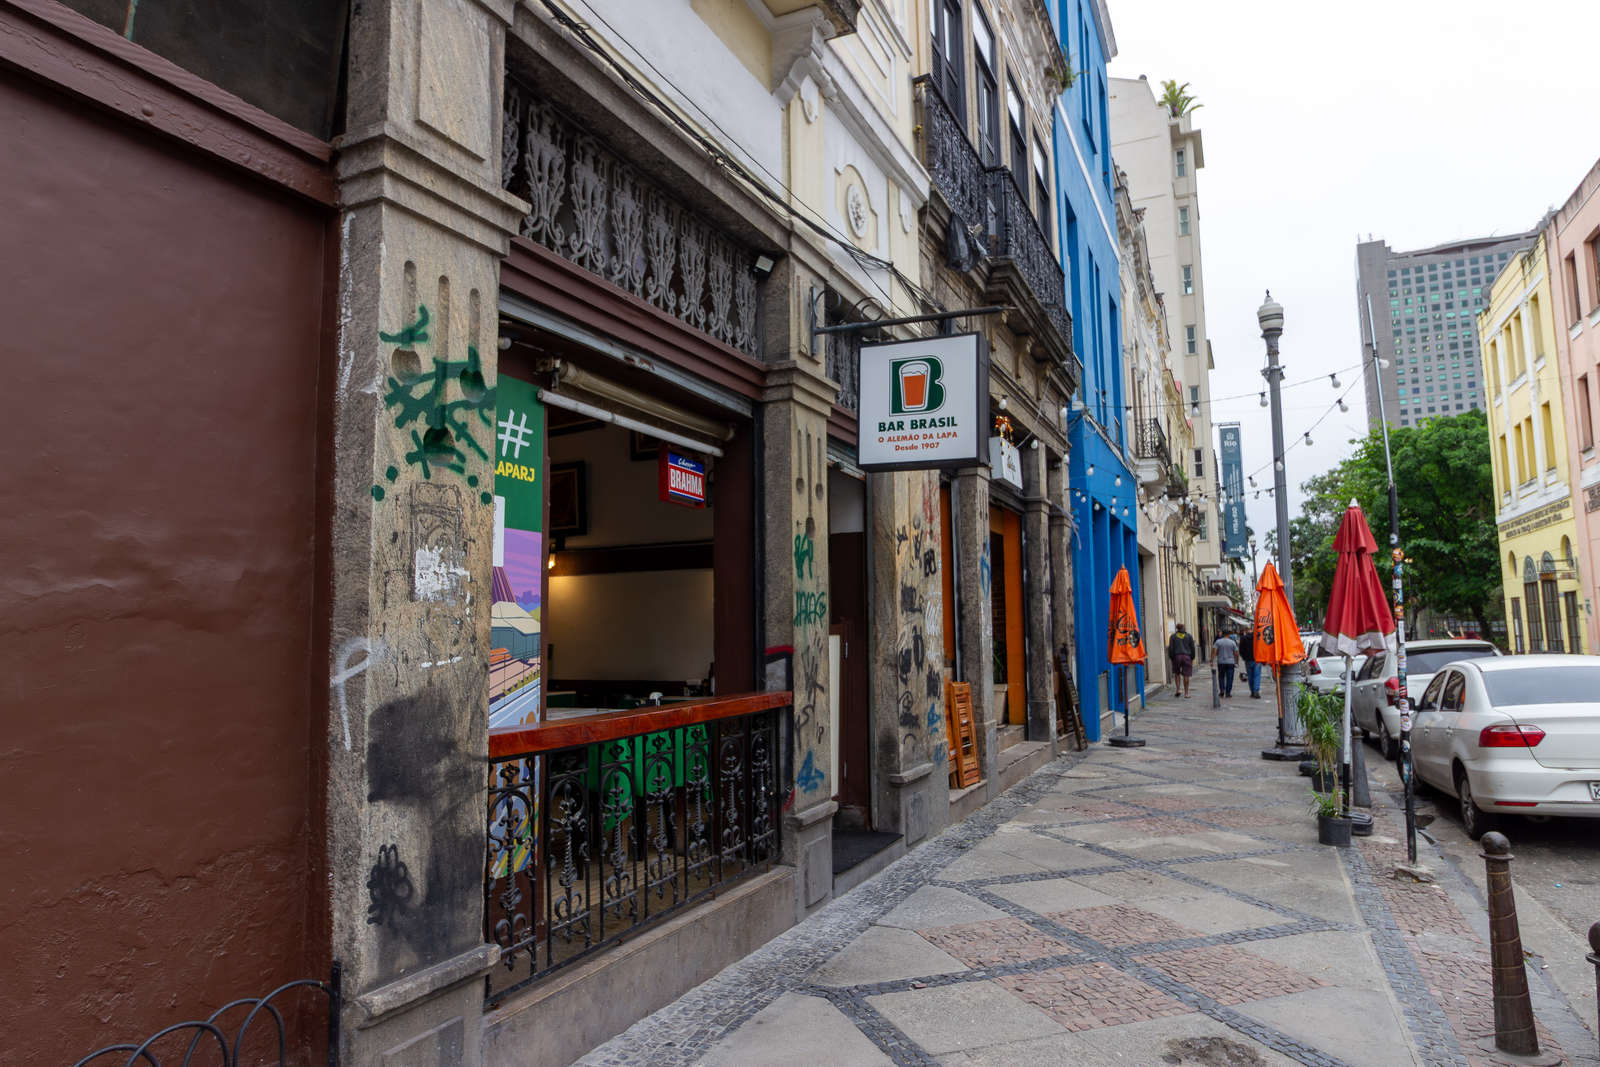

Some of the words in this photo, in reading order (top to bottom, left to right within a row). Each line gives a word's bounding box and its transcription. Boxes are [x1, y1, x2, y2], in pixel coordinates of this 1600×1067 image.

[878, 421, 904, 432] BAR
[910, 416, 958, 430] BRASIL
[936, 431, 958, 440] LAPA
[895, 443, 919, 451] Desde
[921, 442, 940, 450] 1907
[494, 460, 536, 482] APARJ
[670, 468, 703, 496] BRAHMA
